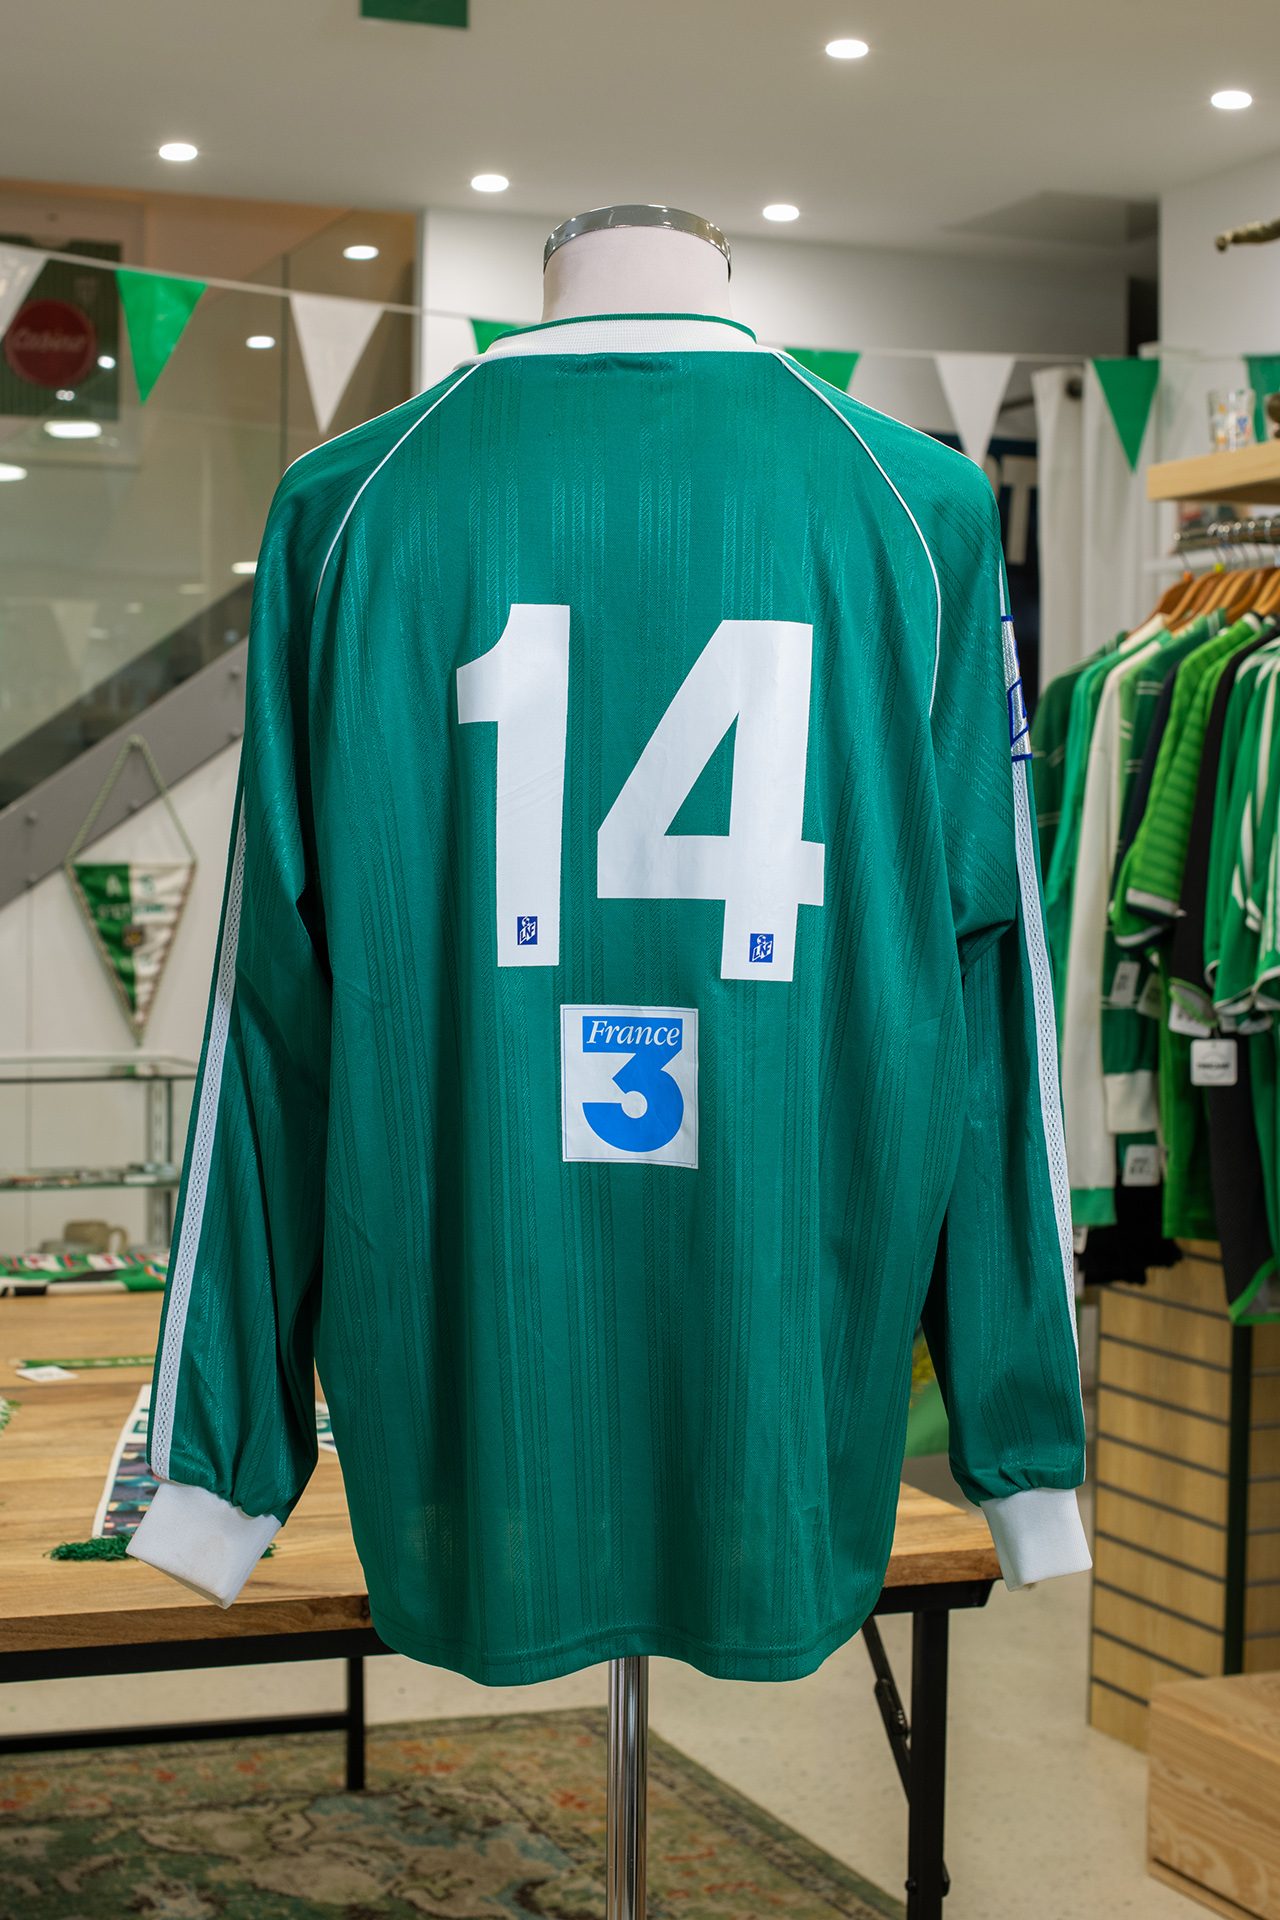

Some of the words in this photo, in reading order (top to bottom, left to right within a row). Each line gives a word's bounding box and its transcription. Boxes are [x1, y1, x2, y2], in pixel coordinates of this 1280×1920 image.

[457, 604, 825, 981] 14
[582, 1016, 684, 1152] 3
[586, 1019, 681, 1047] France
